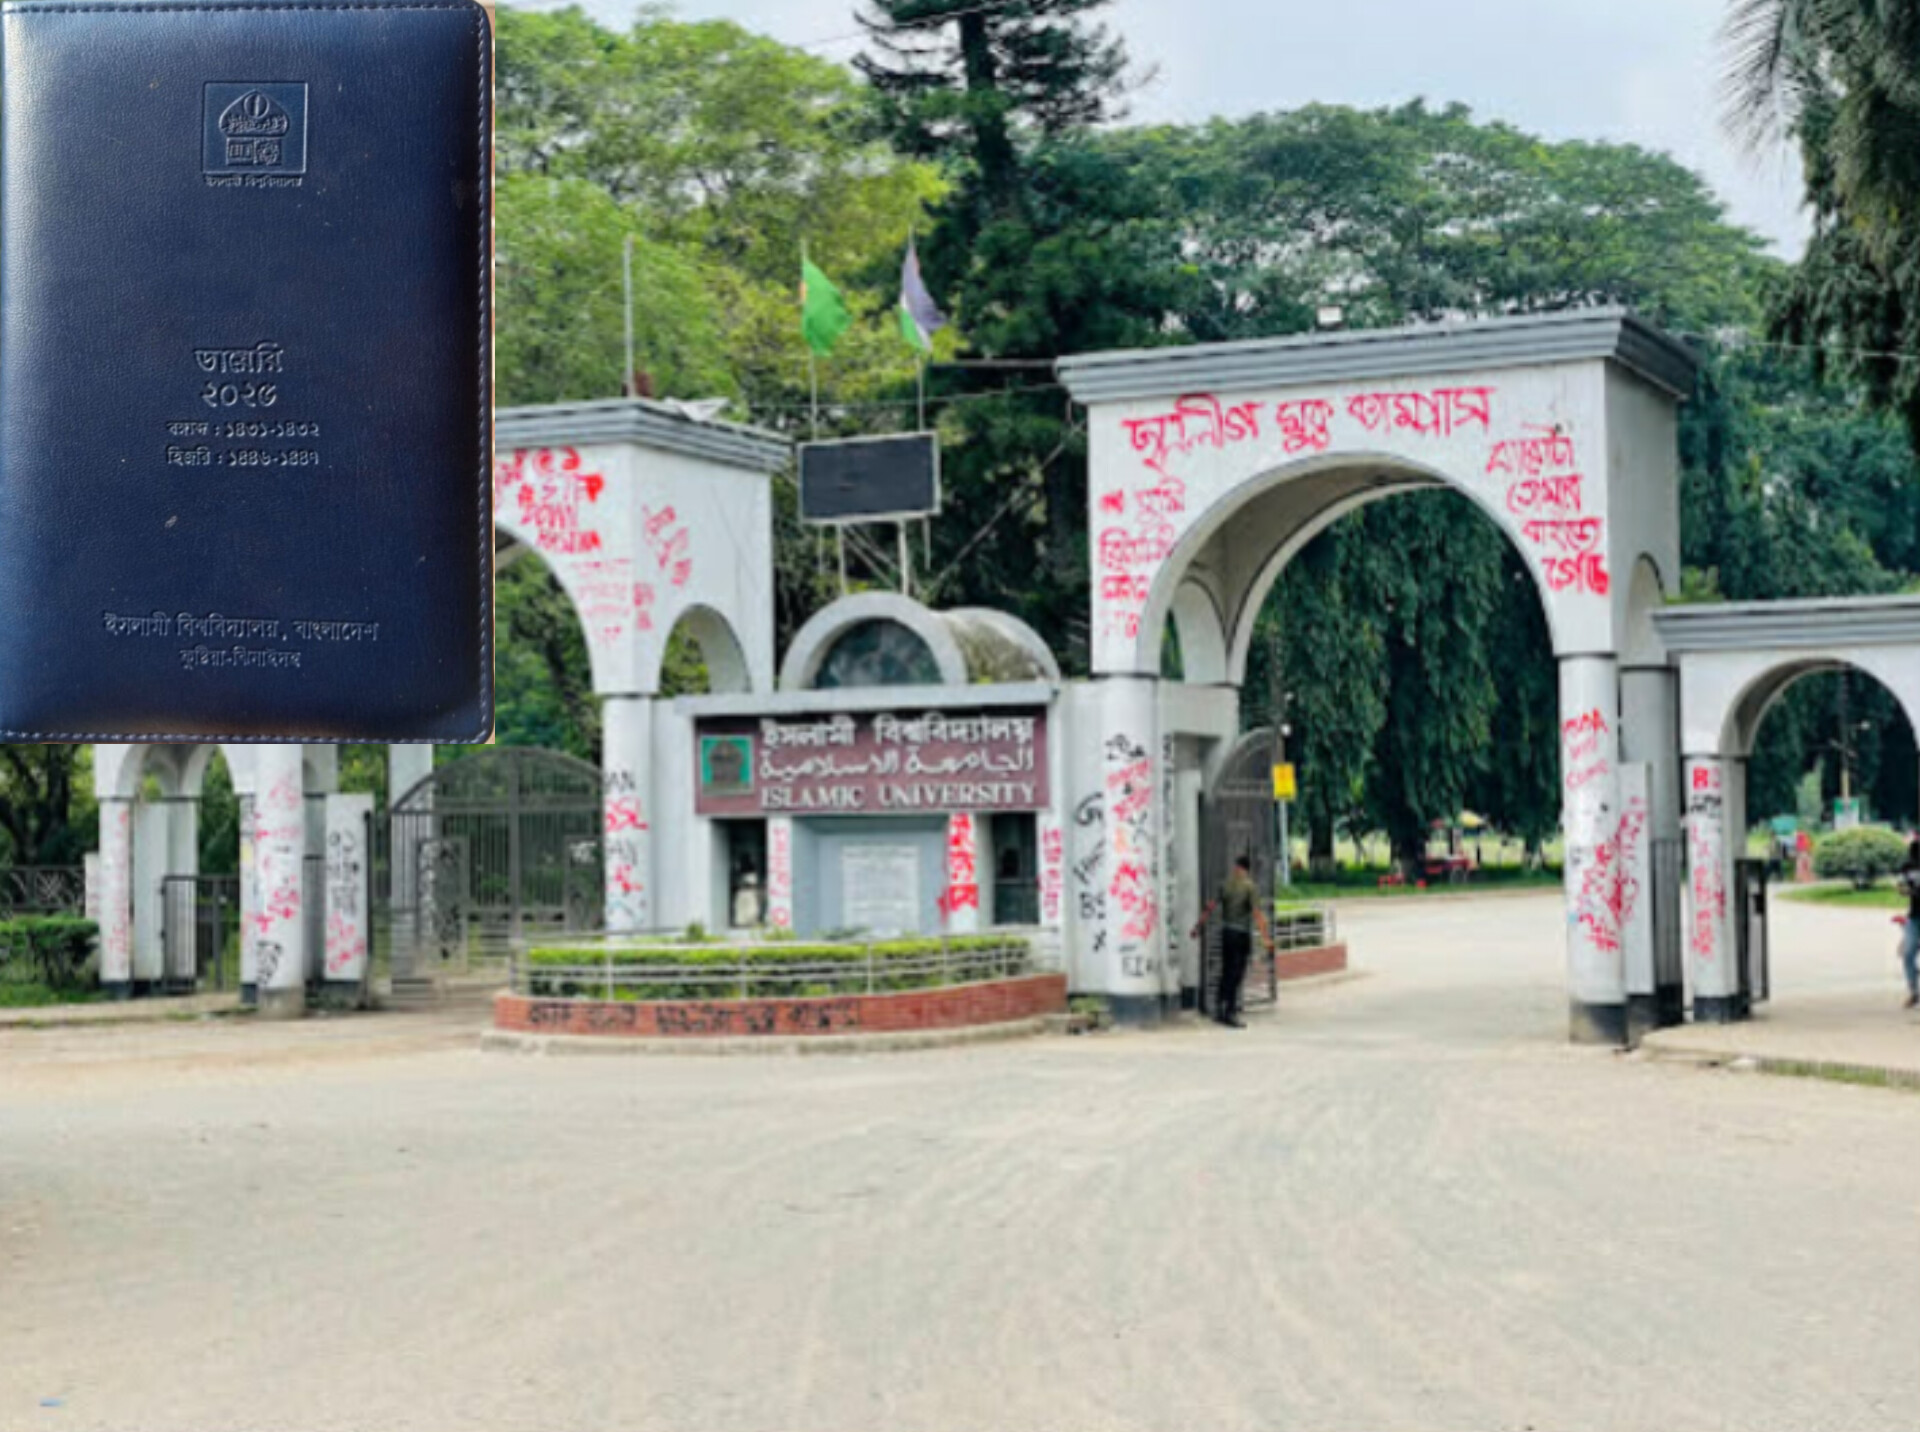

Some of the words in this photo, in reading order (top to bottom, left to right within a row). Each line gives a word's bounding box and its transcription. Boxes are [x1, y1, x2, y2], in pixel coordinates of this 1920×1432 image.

[201, 381, 278, 408] ২০২৫
[103, 611, 171, 638] ইসলামী
[293, 619, 380, 642] বাংলাদেশ
[759, 715, 855, 748] ইসলামী
[872, 712, 1036, 746] বিশ্ববিদ্যালয়
[905, 747, 1035, 775] الجامعة
[760, 784, 865, 809] ISLAMIC
[878, 782, 1036, 807] UNIVERSITY
